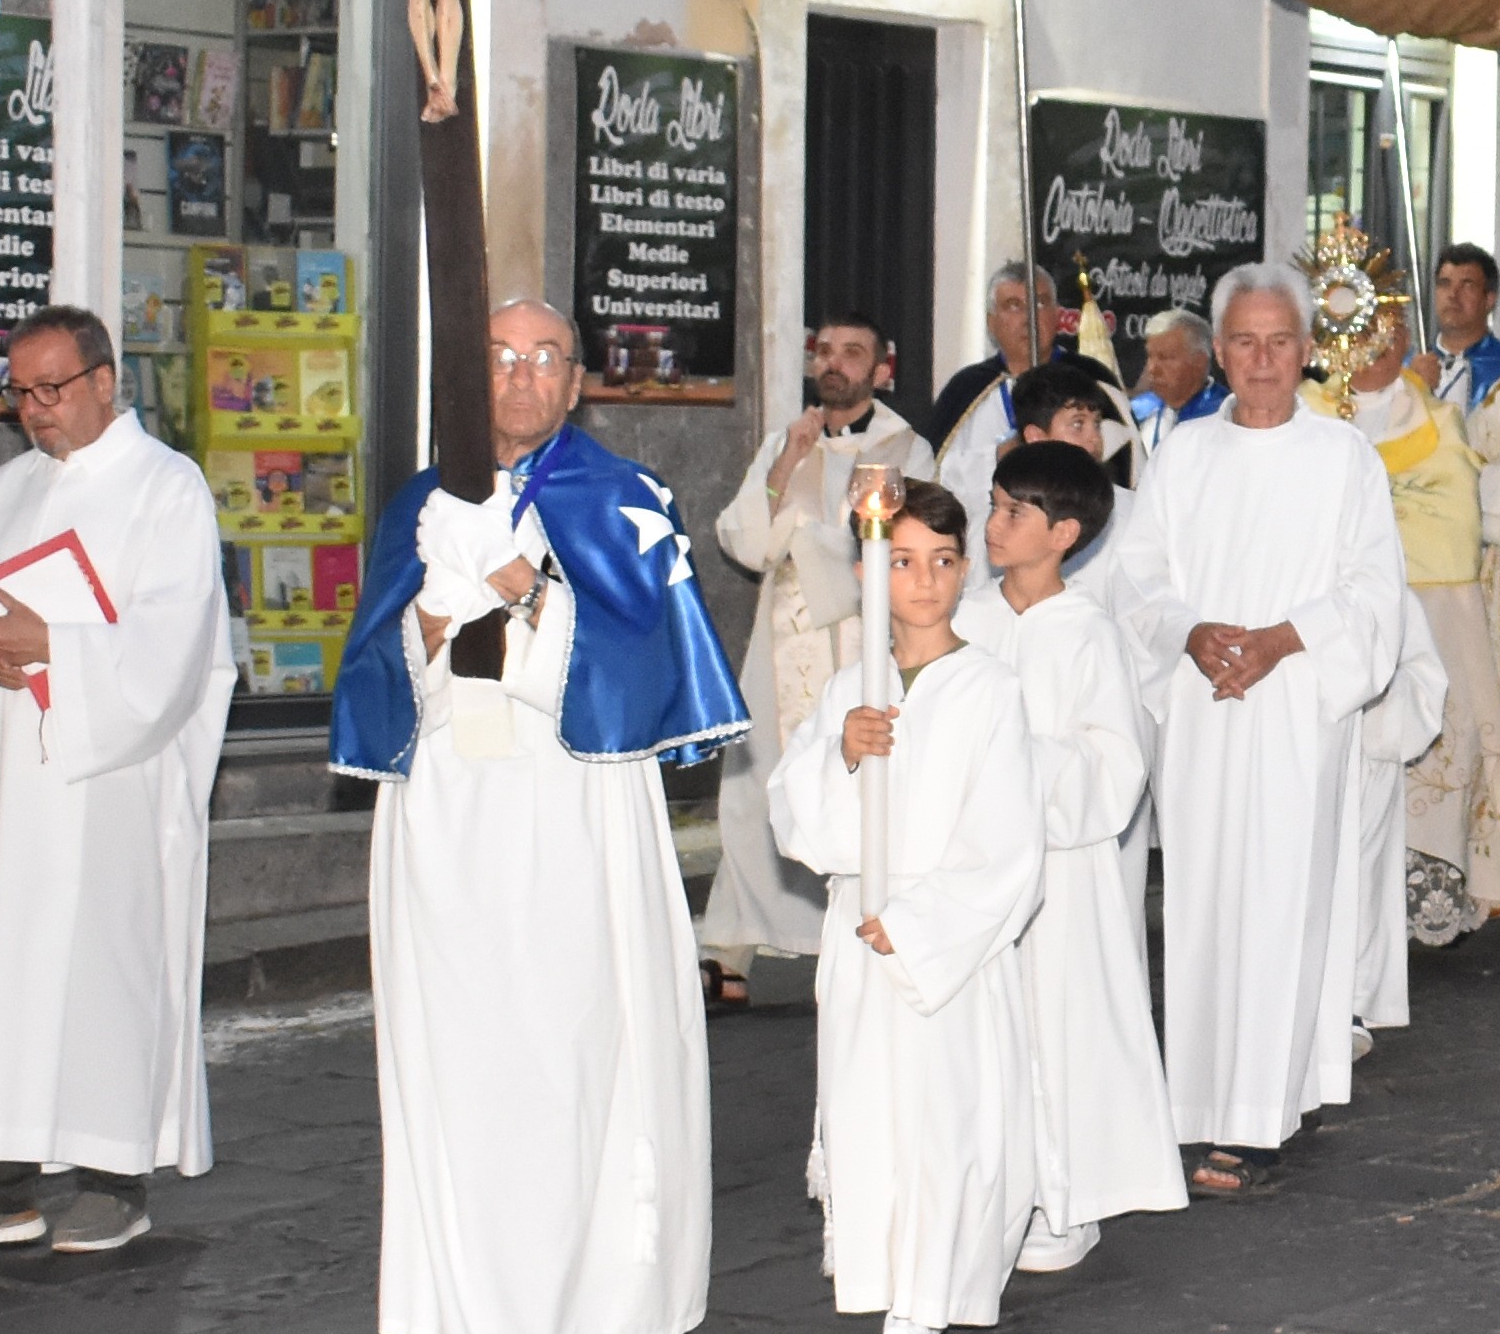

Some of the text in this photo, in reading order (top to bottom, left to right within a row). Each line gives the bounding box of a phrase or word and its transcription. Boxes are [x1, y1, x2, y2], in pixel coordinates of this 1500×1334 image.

[17, 170, 54, 195] tes
[589, 155, 726, 185] Libri di varia
[589, 184, 726, 212] Libri di testo
[600, 212, 716, 239] Elementari
[628, 241, 689, 264] Medie
[607, 268, 708, 292] Superiori
[592, 295, 721, 320] Universitari
